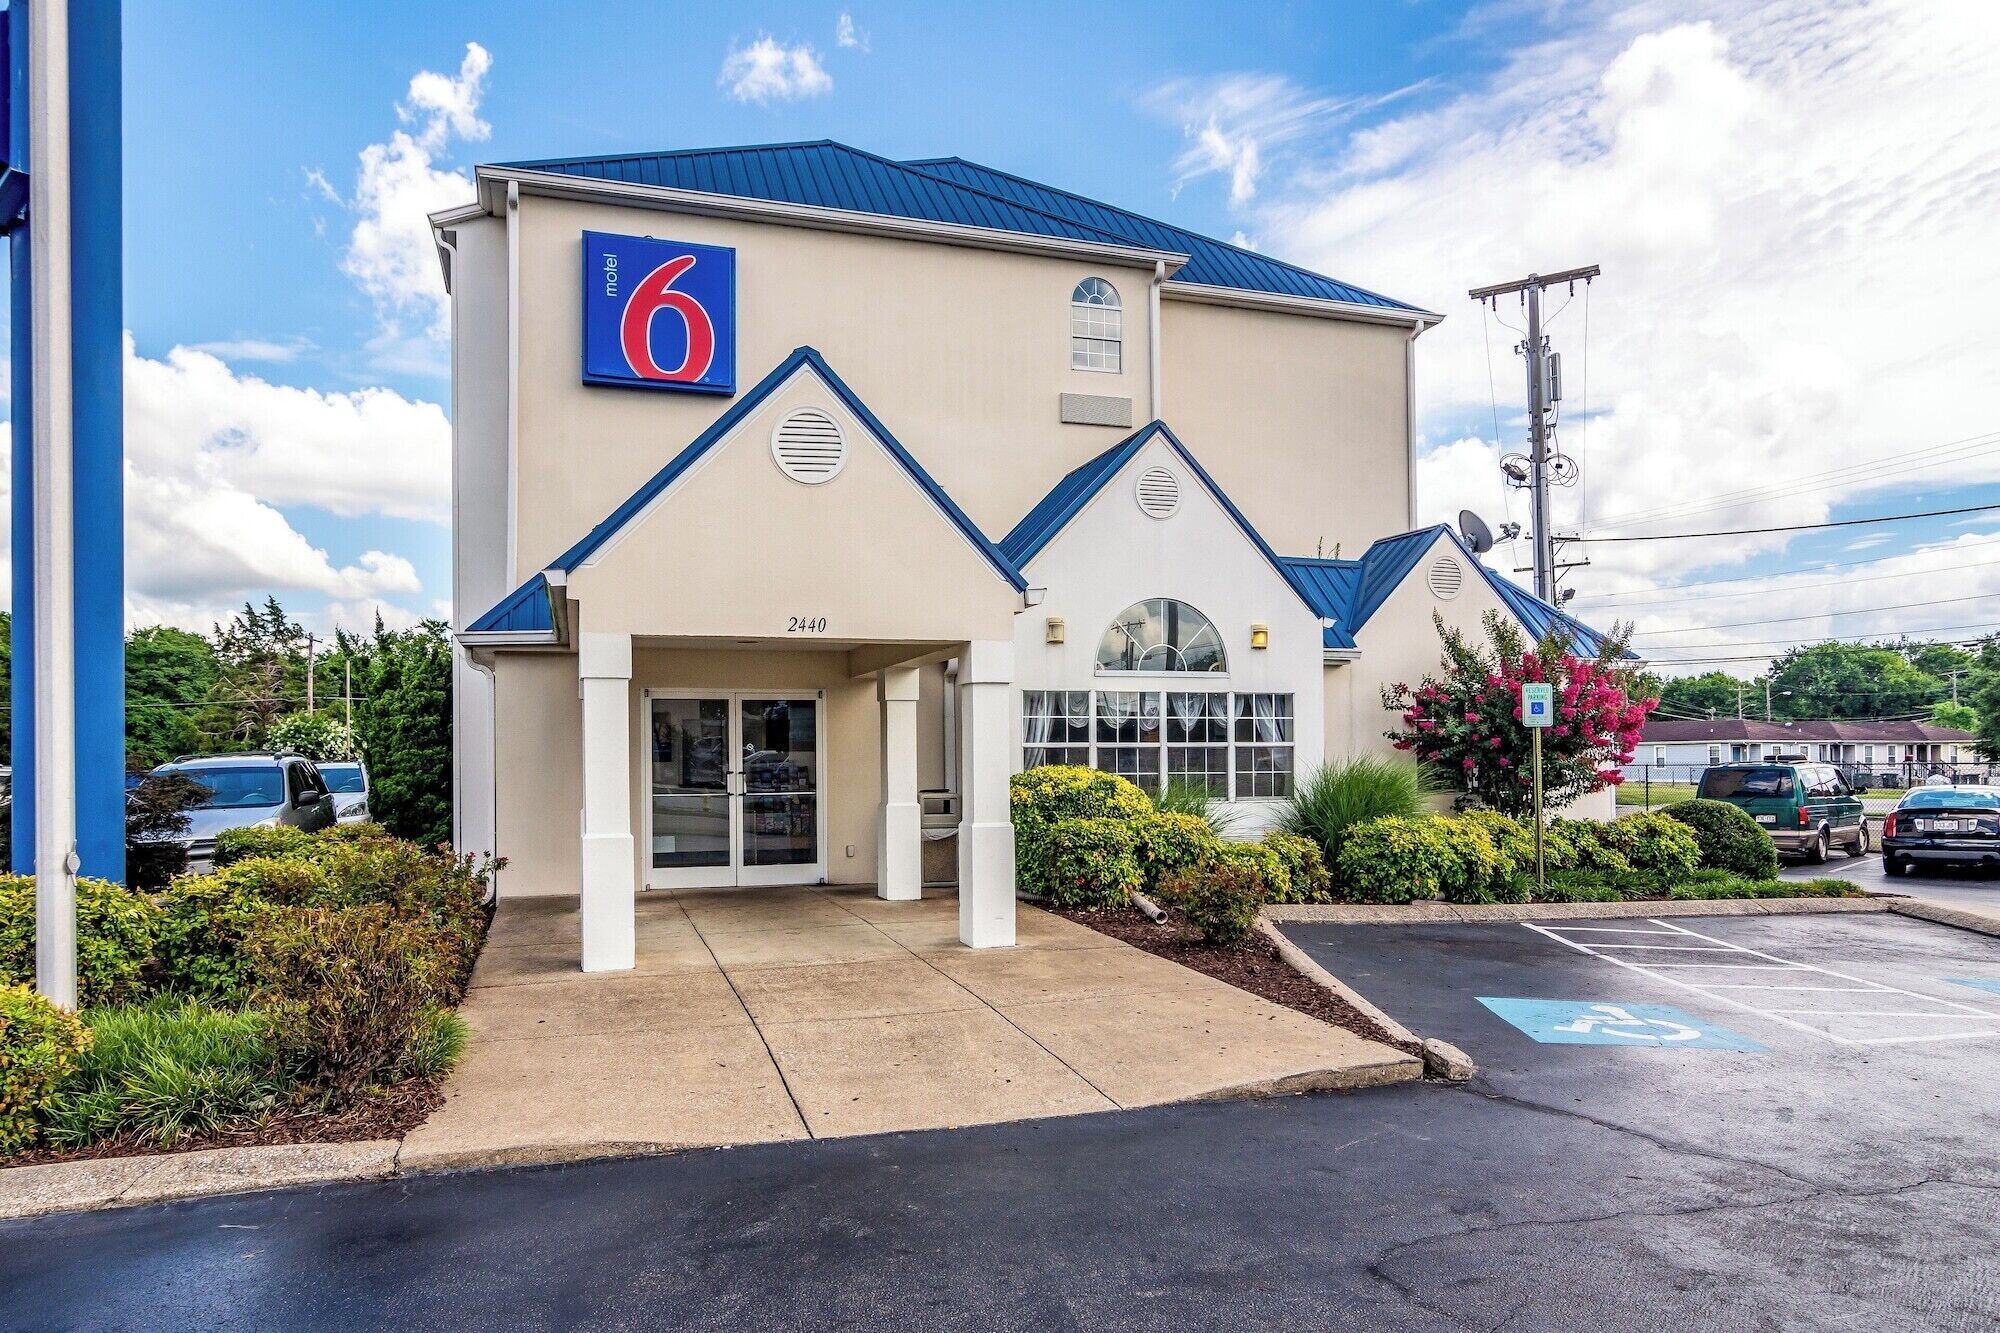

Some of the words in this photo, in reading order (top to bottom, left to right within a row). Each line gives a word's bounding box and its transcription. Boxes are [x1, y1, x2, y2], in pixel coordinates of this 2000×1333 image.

[603, 253, 618, 297] motel
[620, 255, 715, 383] 6
[787, 616, 827, 633] 2440
